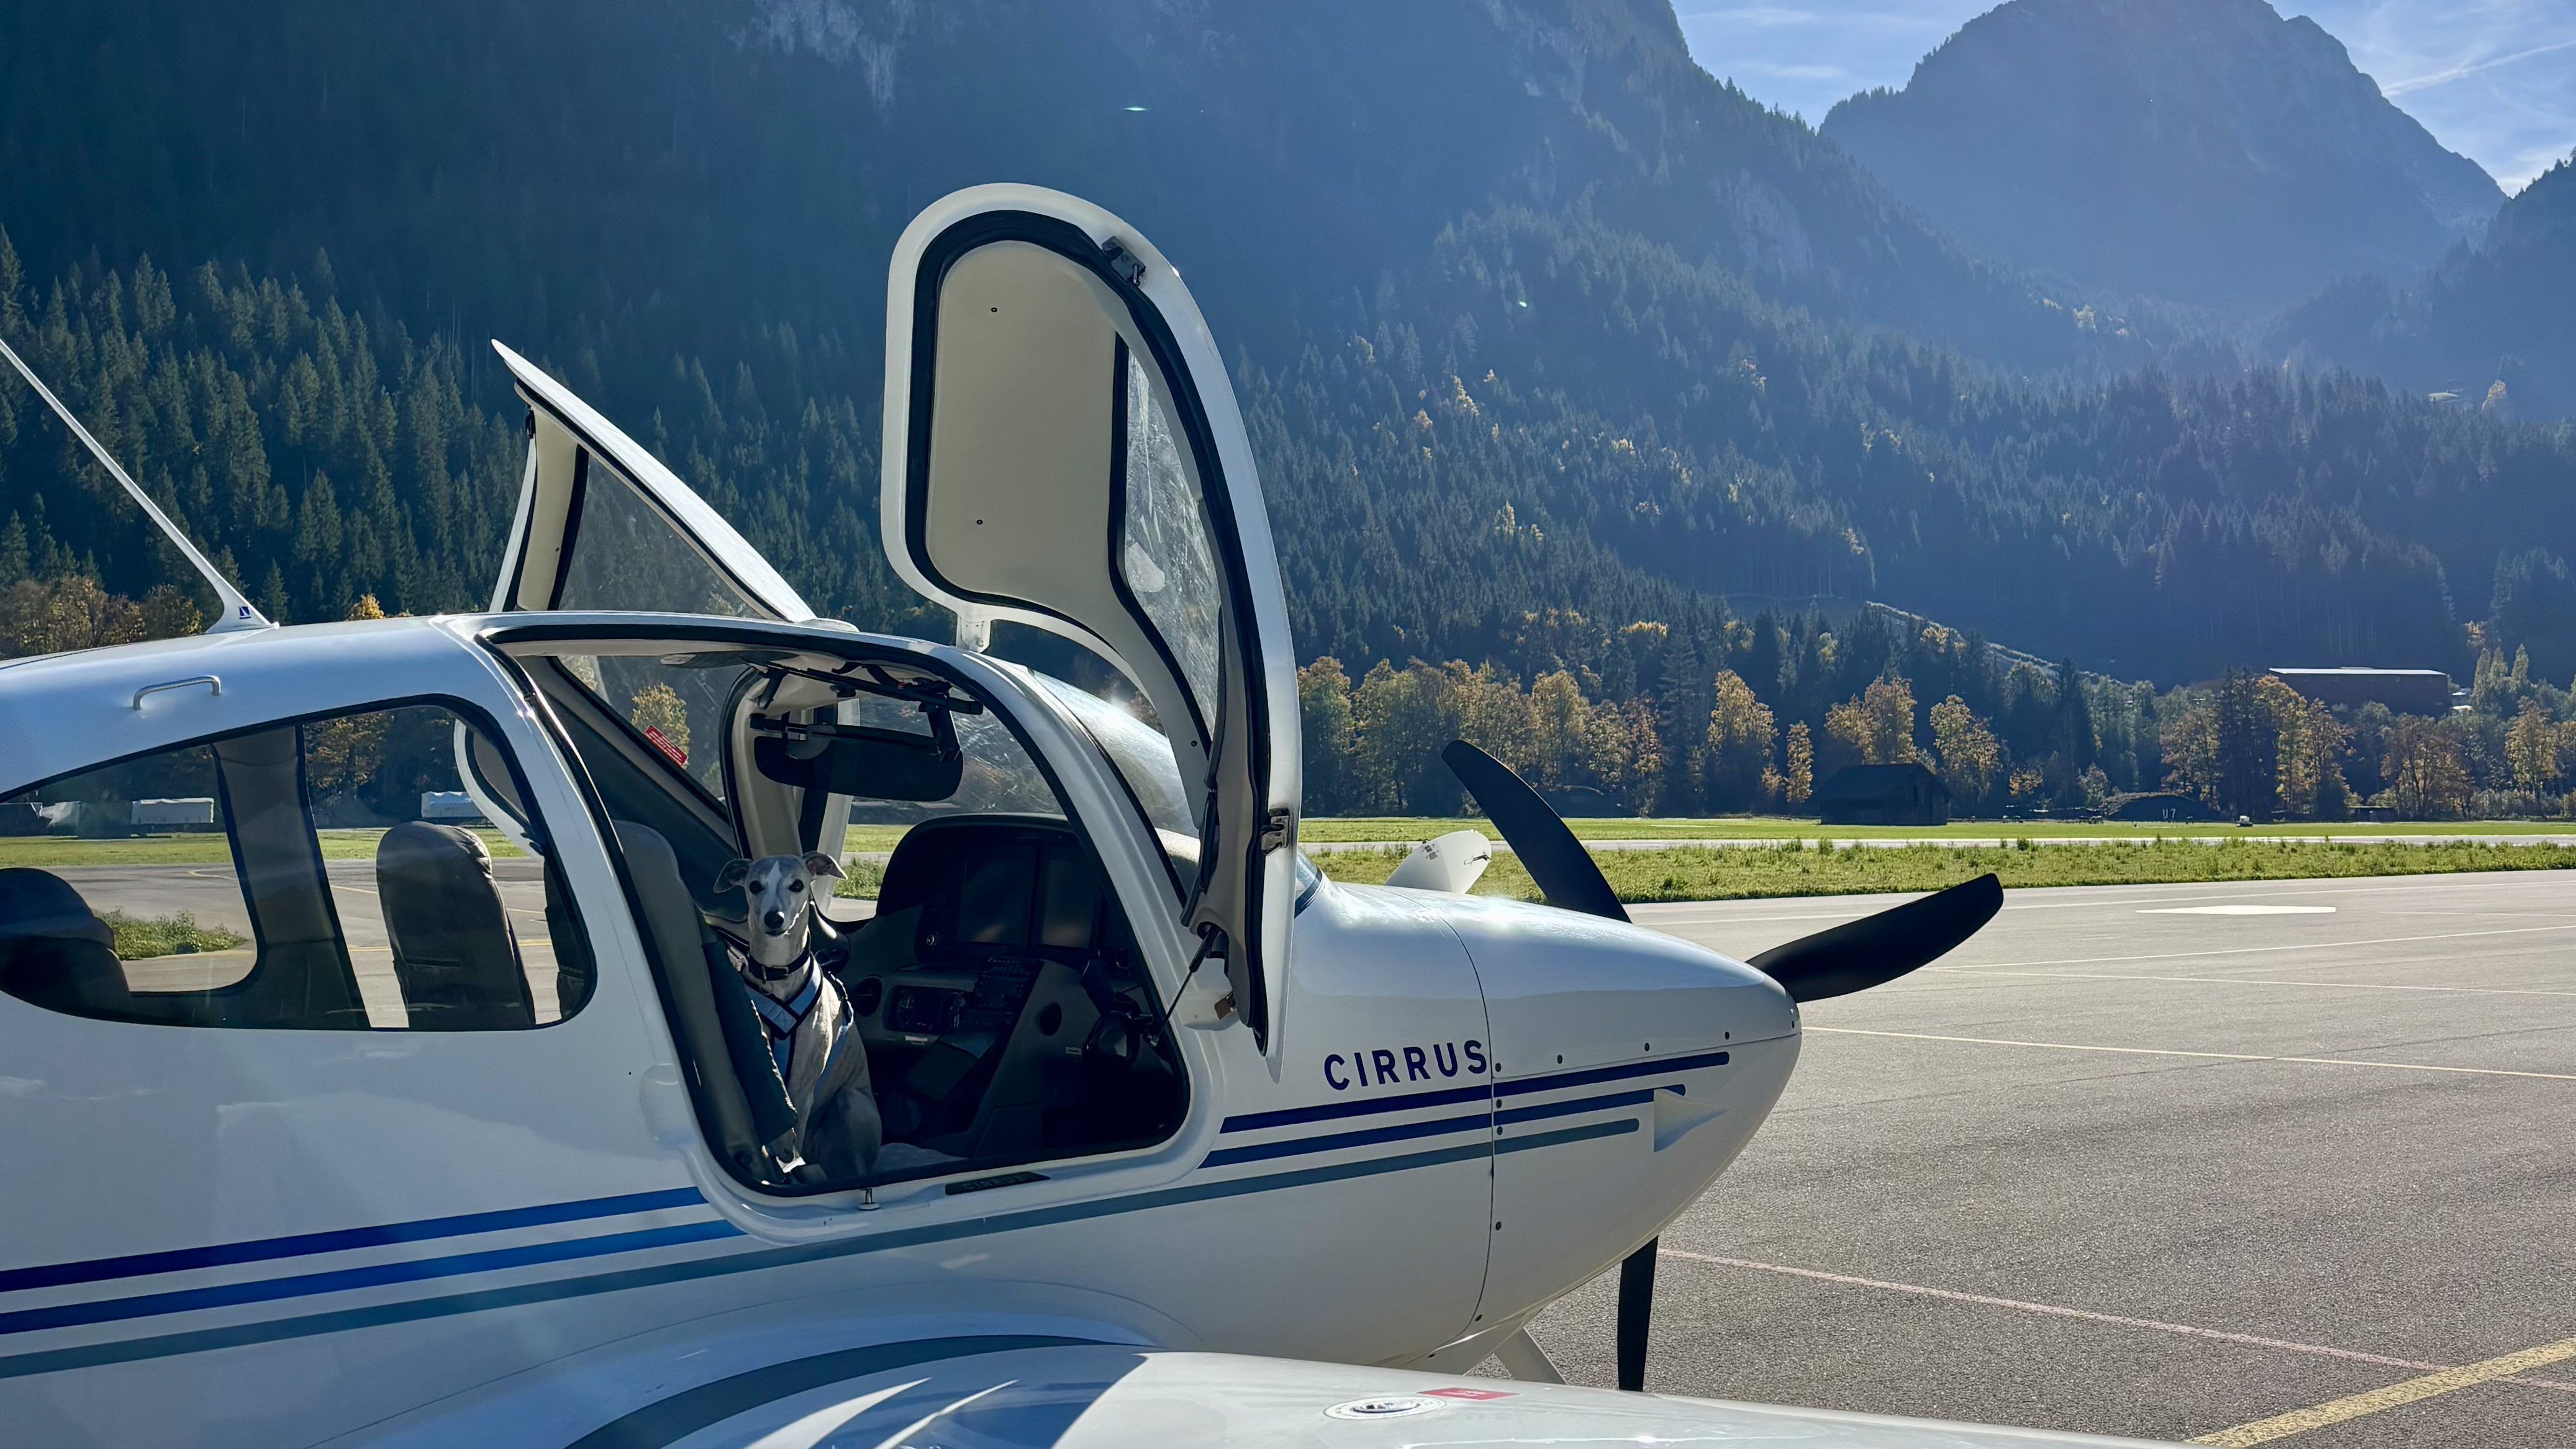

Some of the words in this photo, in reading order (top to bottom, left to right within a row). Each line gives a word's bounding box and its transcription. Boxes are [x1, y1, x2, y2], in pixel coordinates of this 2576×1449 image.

[2162, 808, 2168, 819] U
[2171, 808, 2176, 819] 7
[1324, 1040, 1487, 1090] CIRRUS
